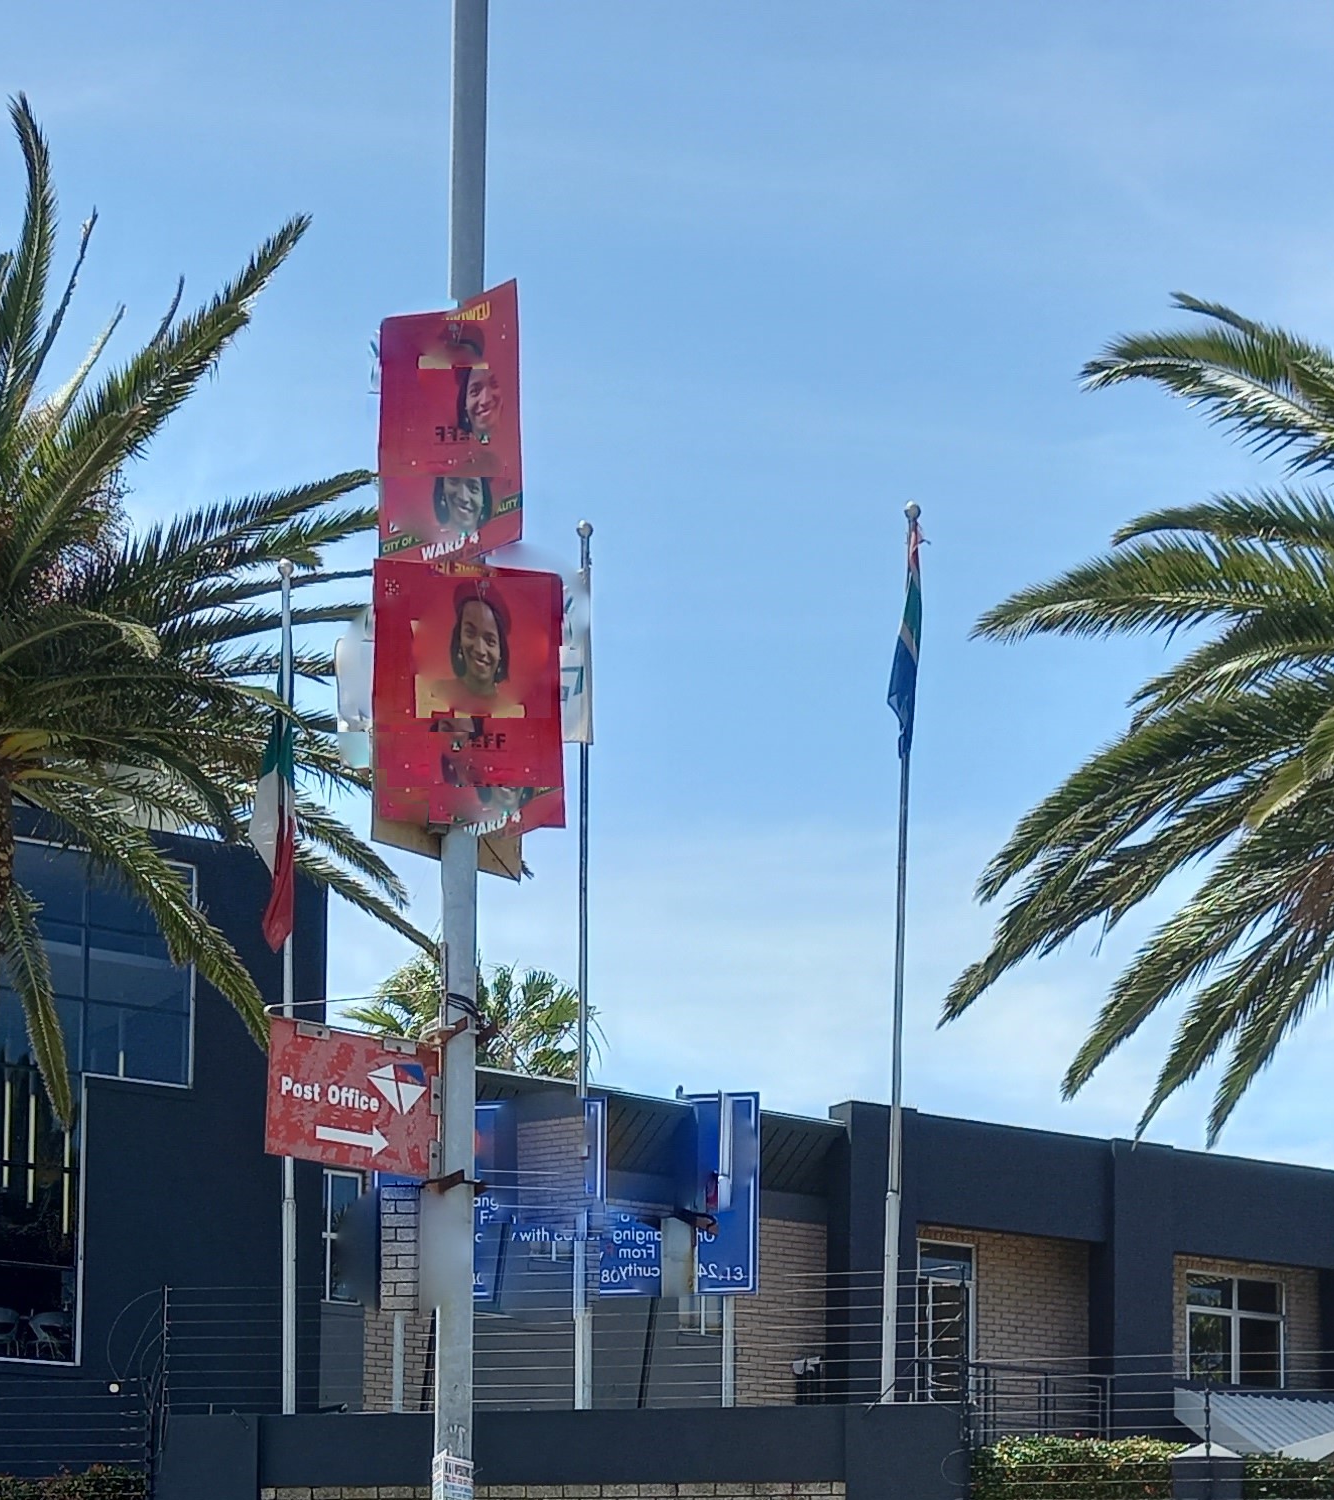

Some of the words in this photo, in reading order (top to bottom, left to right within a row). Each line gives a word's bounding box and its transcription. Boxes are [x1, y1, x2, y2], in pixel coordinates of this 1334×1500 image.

[382, 540, 400, 553] CITY
[421, 537, 466, 561] WARD
[469, 532, 480, 545] 4
[463, 817, 508, 837] WARD
[511, 810, 522, 823] 4
[281, 1076, 321, 1102] Post
[327, 1084, 380, 1112] Office
